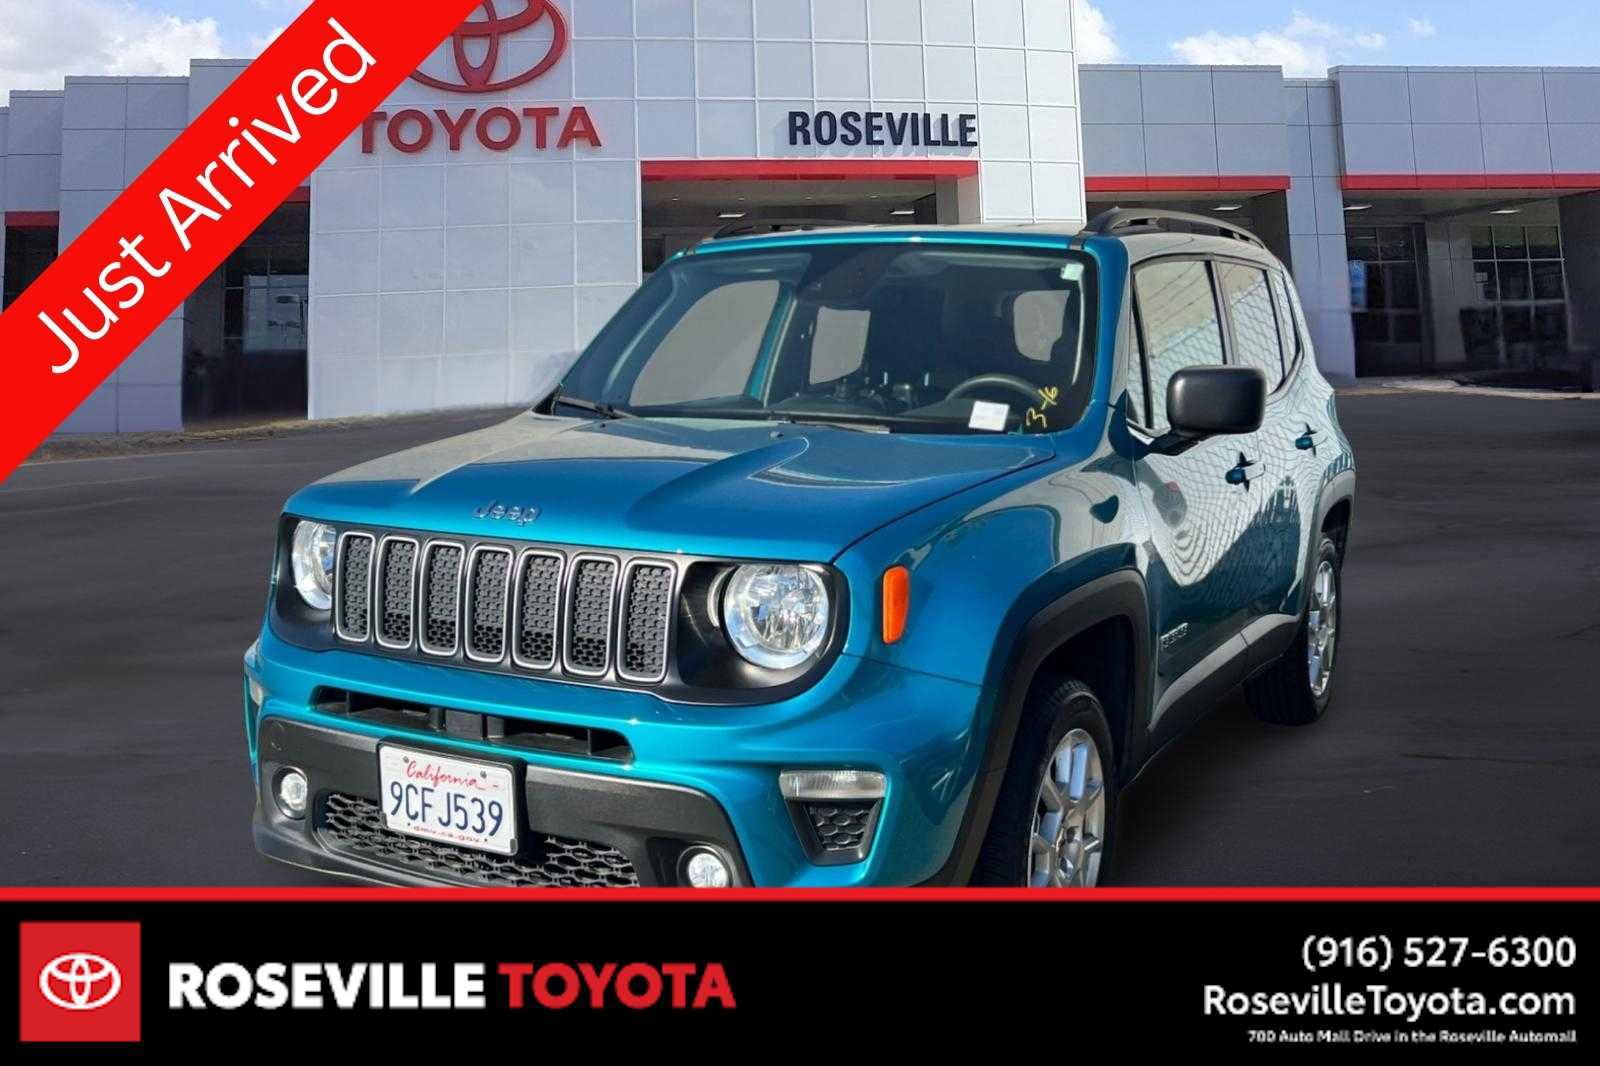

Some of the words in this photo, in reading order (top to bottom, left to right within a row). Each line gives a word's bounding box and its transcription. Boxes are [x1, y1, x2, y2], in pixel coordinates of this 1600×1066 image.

[360, 106, 602, 154] TOYOTA
[788, 110, 978, 147] ROSEVILLE
[472, 499, 541, 527] Jeep
[405, 759, 486, 791] California
[389, 780, 504, 837] 9CFJ539
